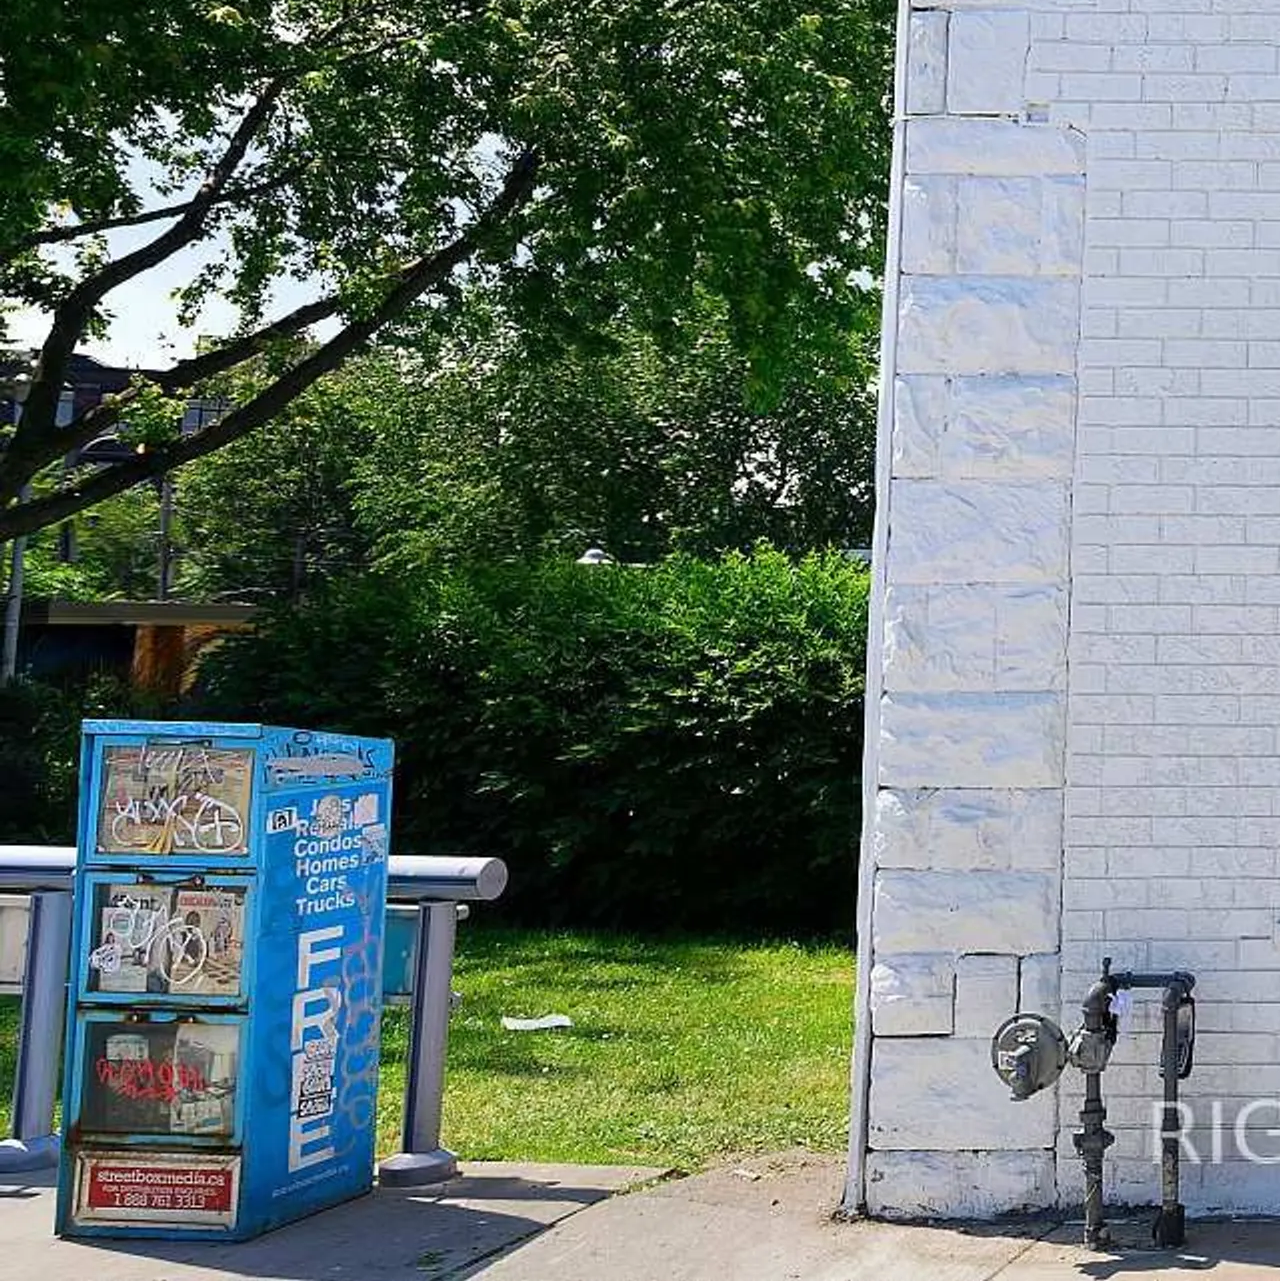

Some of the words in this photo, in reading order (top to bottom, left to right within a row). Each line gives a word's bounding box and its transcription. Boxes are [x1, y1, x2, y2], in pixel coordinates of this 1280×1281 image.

[310, 798, 352, 816] Js
[294, 834, 362, 858] Condos
[296, 854, 360, 877] Homes
[306, 874, 348, 895] Cars
[296, 892, 355, 916] Trucks
[97, 1169, 225, 1186] streetboxmedia.ca
